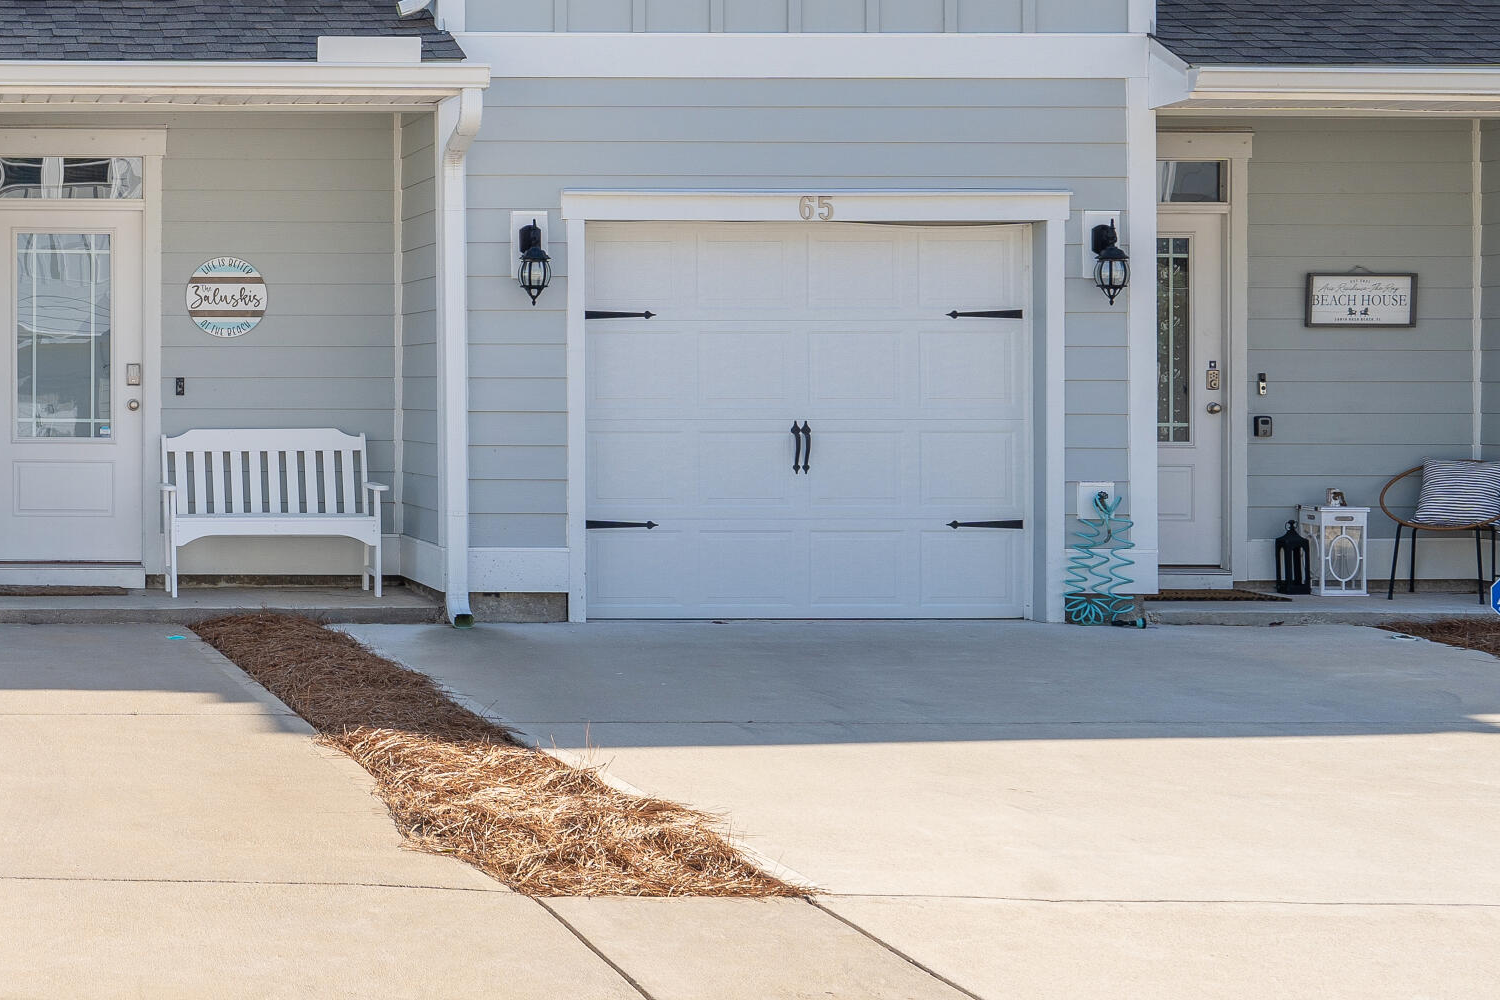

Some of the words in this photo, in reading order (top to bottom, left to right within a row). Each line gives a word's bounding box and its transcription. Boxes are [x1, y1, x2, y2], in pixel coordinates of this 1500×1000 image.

[798, 195, 834, 221] 65
[201, 262, 217, 275] LIFE
[218, 258, 226, 267] IS
[228, 257, 253, 275] BETTER
[190, 284, 263, 309] Zaluskis
[200, 284, 213, 293] The
[1311, 294, 1357, 307] BEACH
[1361, 294, 1408, 307] HOUSE
[200, 319, 210, 330] AT
[210, 324, 224, 336] THE
[227, 320, 251, 336] BEACH
